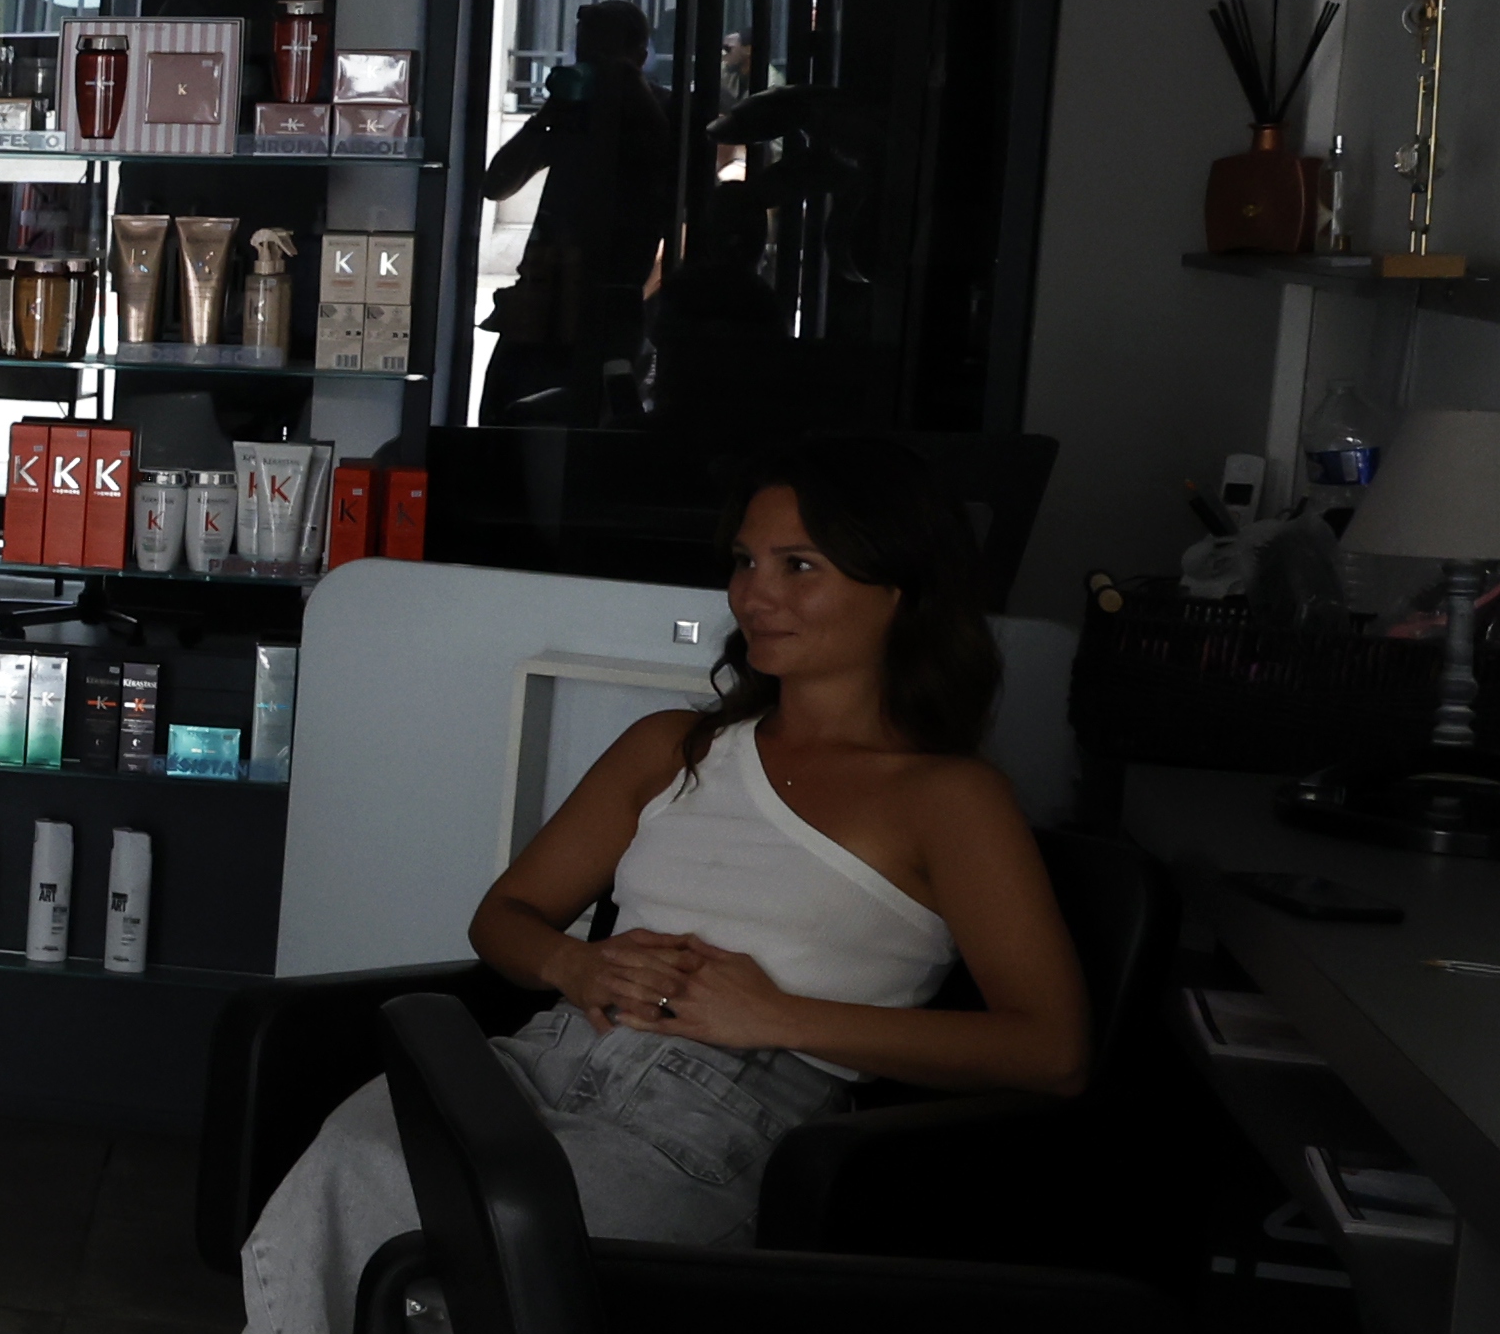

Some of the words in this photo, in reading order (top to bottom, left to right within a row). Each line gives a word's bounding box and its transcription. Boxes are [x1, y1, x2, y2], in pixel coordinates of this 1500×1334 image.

[178, 82, 187, 97] K
[334, 250, 354, 274] K
[379, 251, 400, 276] K
[13, 455, 39, 486] K
[53, 456, 81, 489] K
[95, 458, 122, 492] K
[270, 474, 291, 503] K
[204, 511, 221, 532] K
[339, 497, 357, 524] K
[96, 695, 108, 710] K
[38, 890, 57, 903] ART
[111, 899, 128, 913] ART
